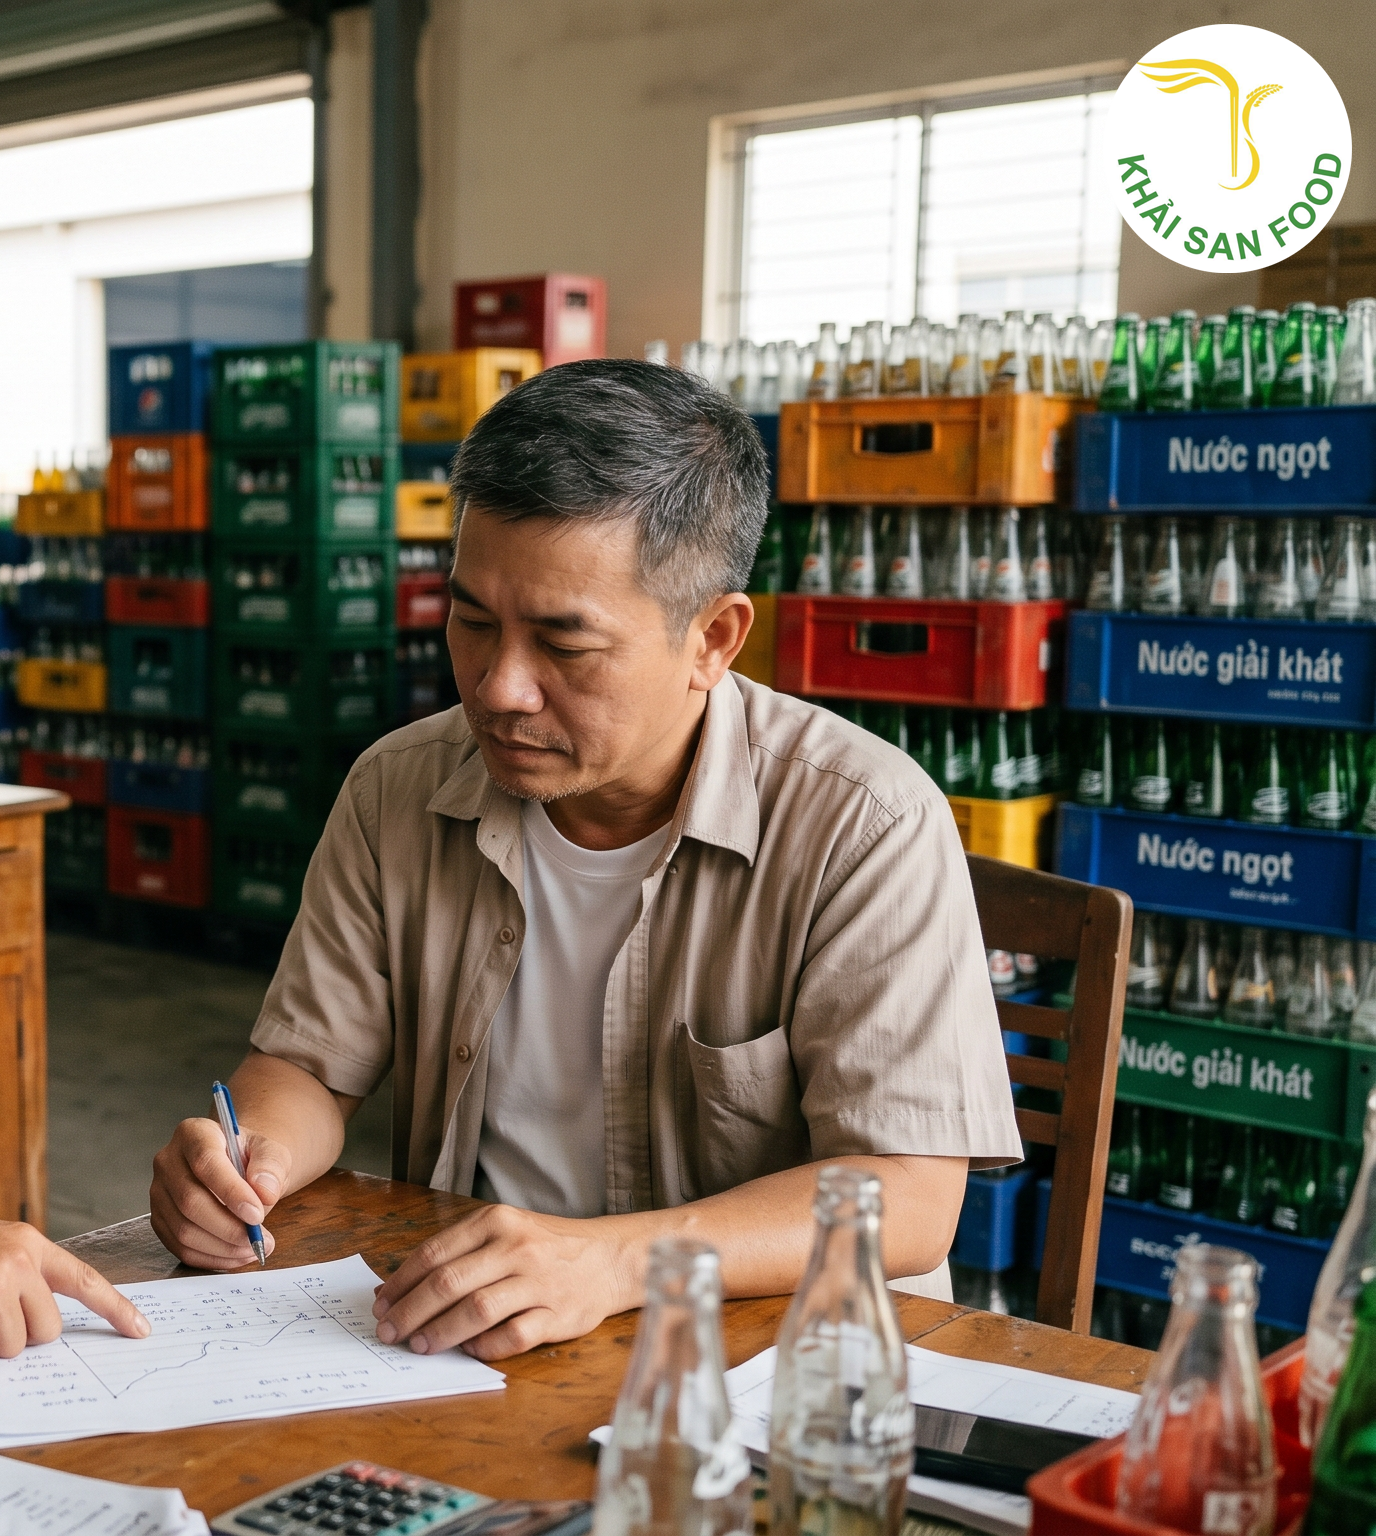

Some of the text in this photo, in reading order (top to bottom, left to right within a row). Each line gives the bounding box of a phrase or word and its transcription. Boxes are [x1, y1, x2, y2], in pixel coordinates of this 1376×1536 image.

[1168, 435, 1332, 481] Nước ngọt
[1138, 639, 1343, 685] Nước giải khát
[1137, 832, 1294, 887] Nước ngọt
[1118, 1034, 1314, 1100] Nước giải khát
